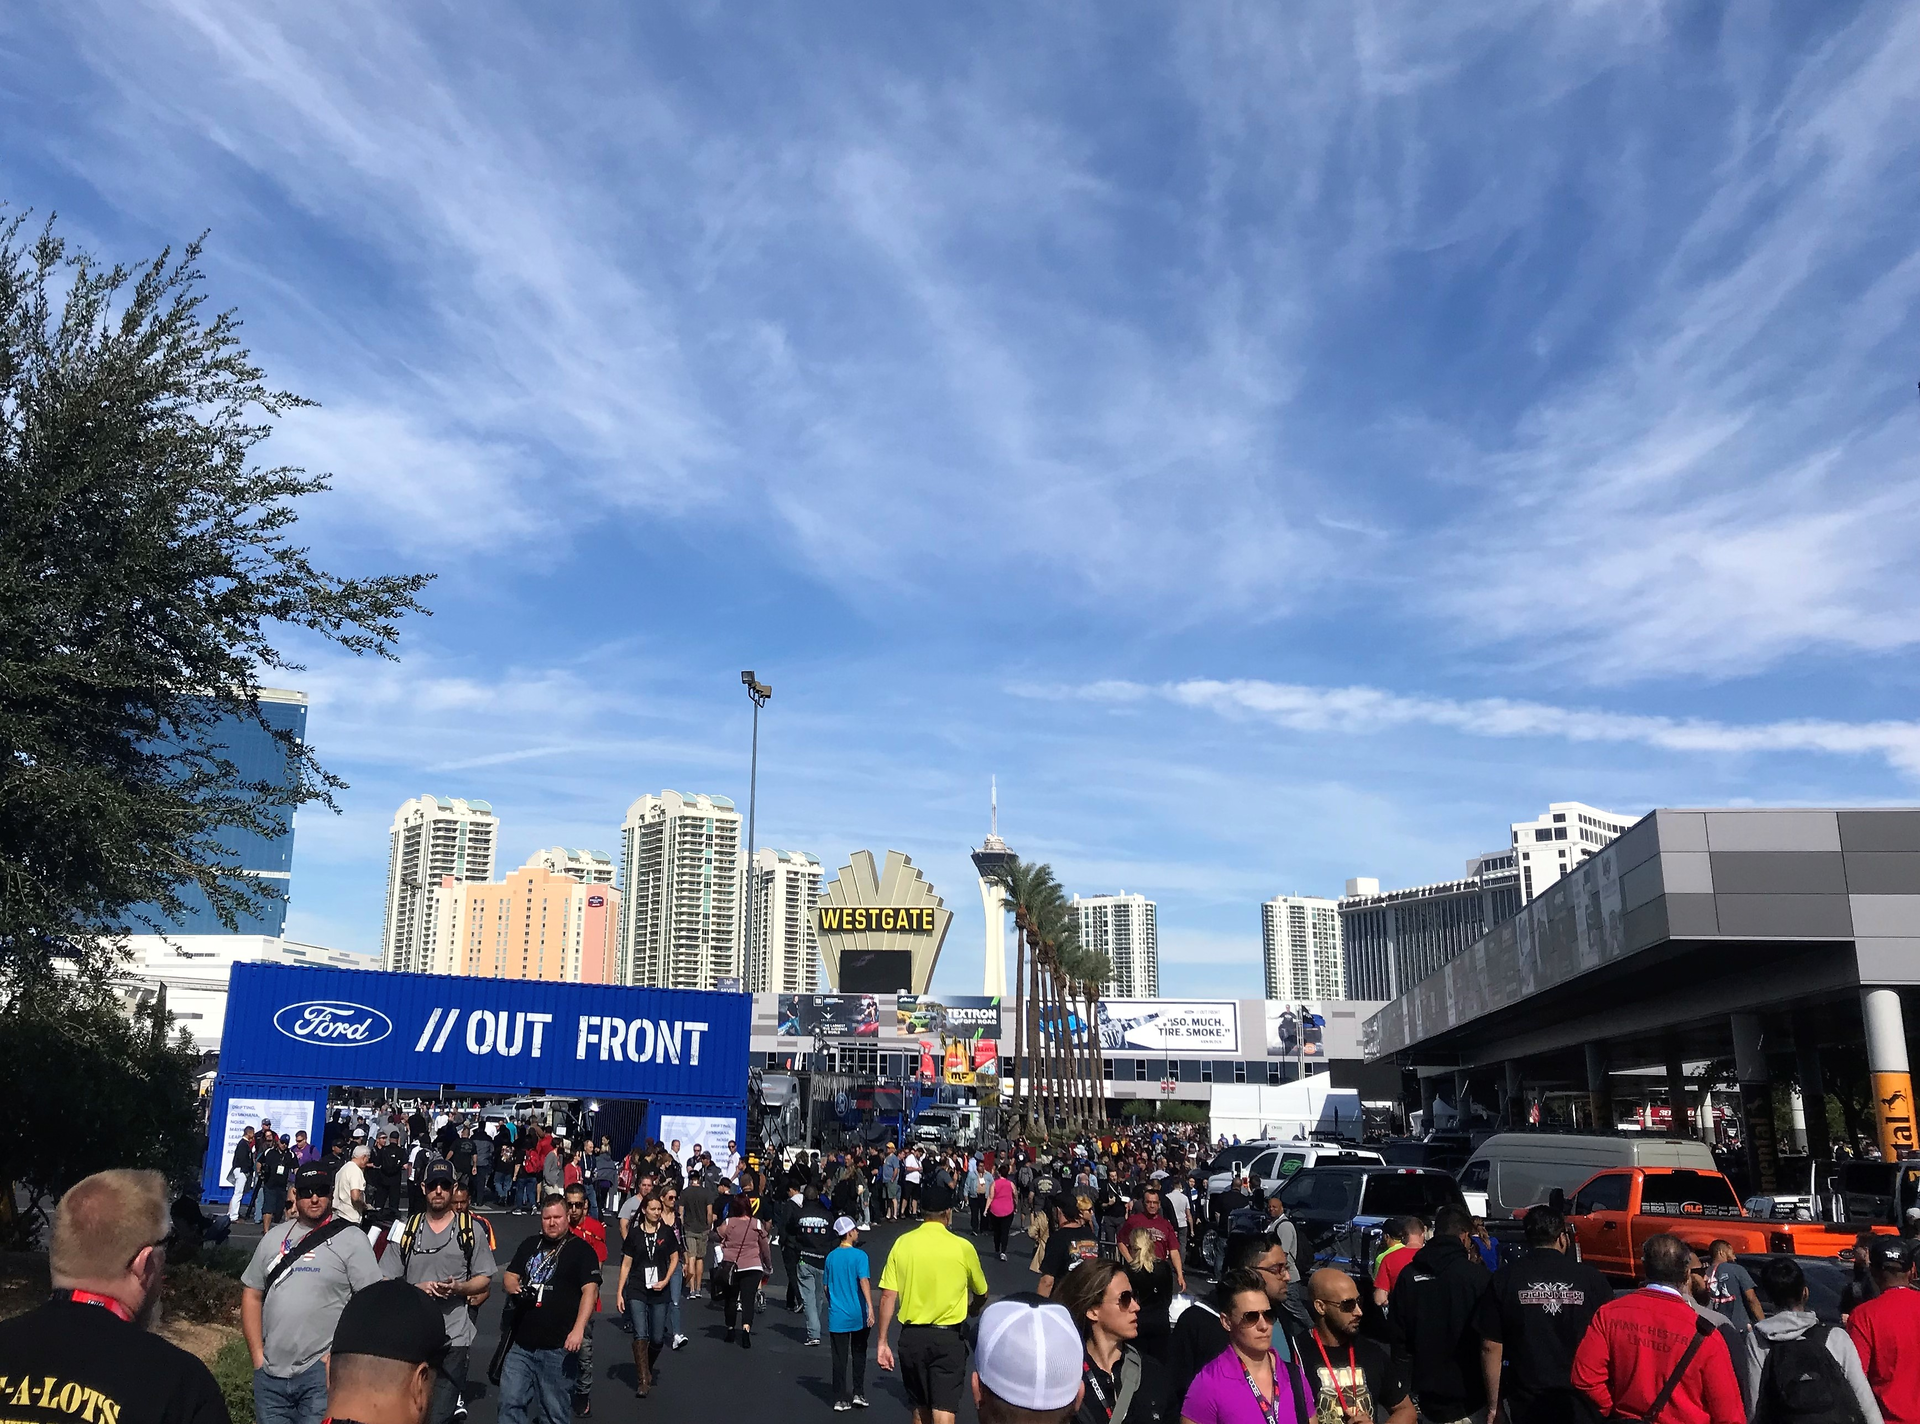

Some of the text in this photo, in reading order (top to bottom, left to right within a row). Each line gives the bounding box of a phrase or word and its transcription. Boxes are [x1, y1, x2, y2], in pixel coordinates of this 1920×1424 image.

[821, 908, 933, 929] WESTGATE
[294, 1006, 373, 1040] Ford
[946, 1008, 997, 1019] TEXTRON
[1191, 1018, 1225, 1027] MUCH.
[465, 1009, 553, 1058] OUT
[576, 1015, 709, 1066] FRONT
[1158, 1027, 1184, 1036] TIRE.
[1611, 1319, 1689, 1346] MANCHESTER
[1626, 1333, 1672, 1353] UNITED
